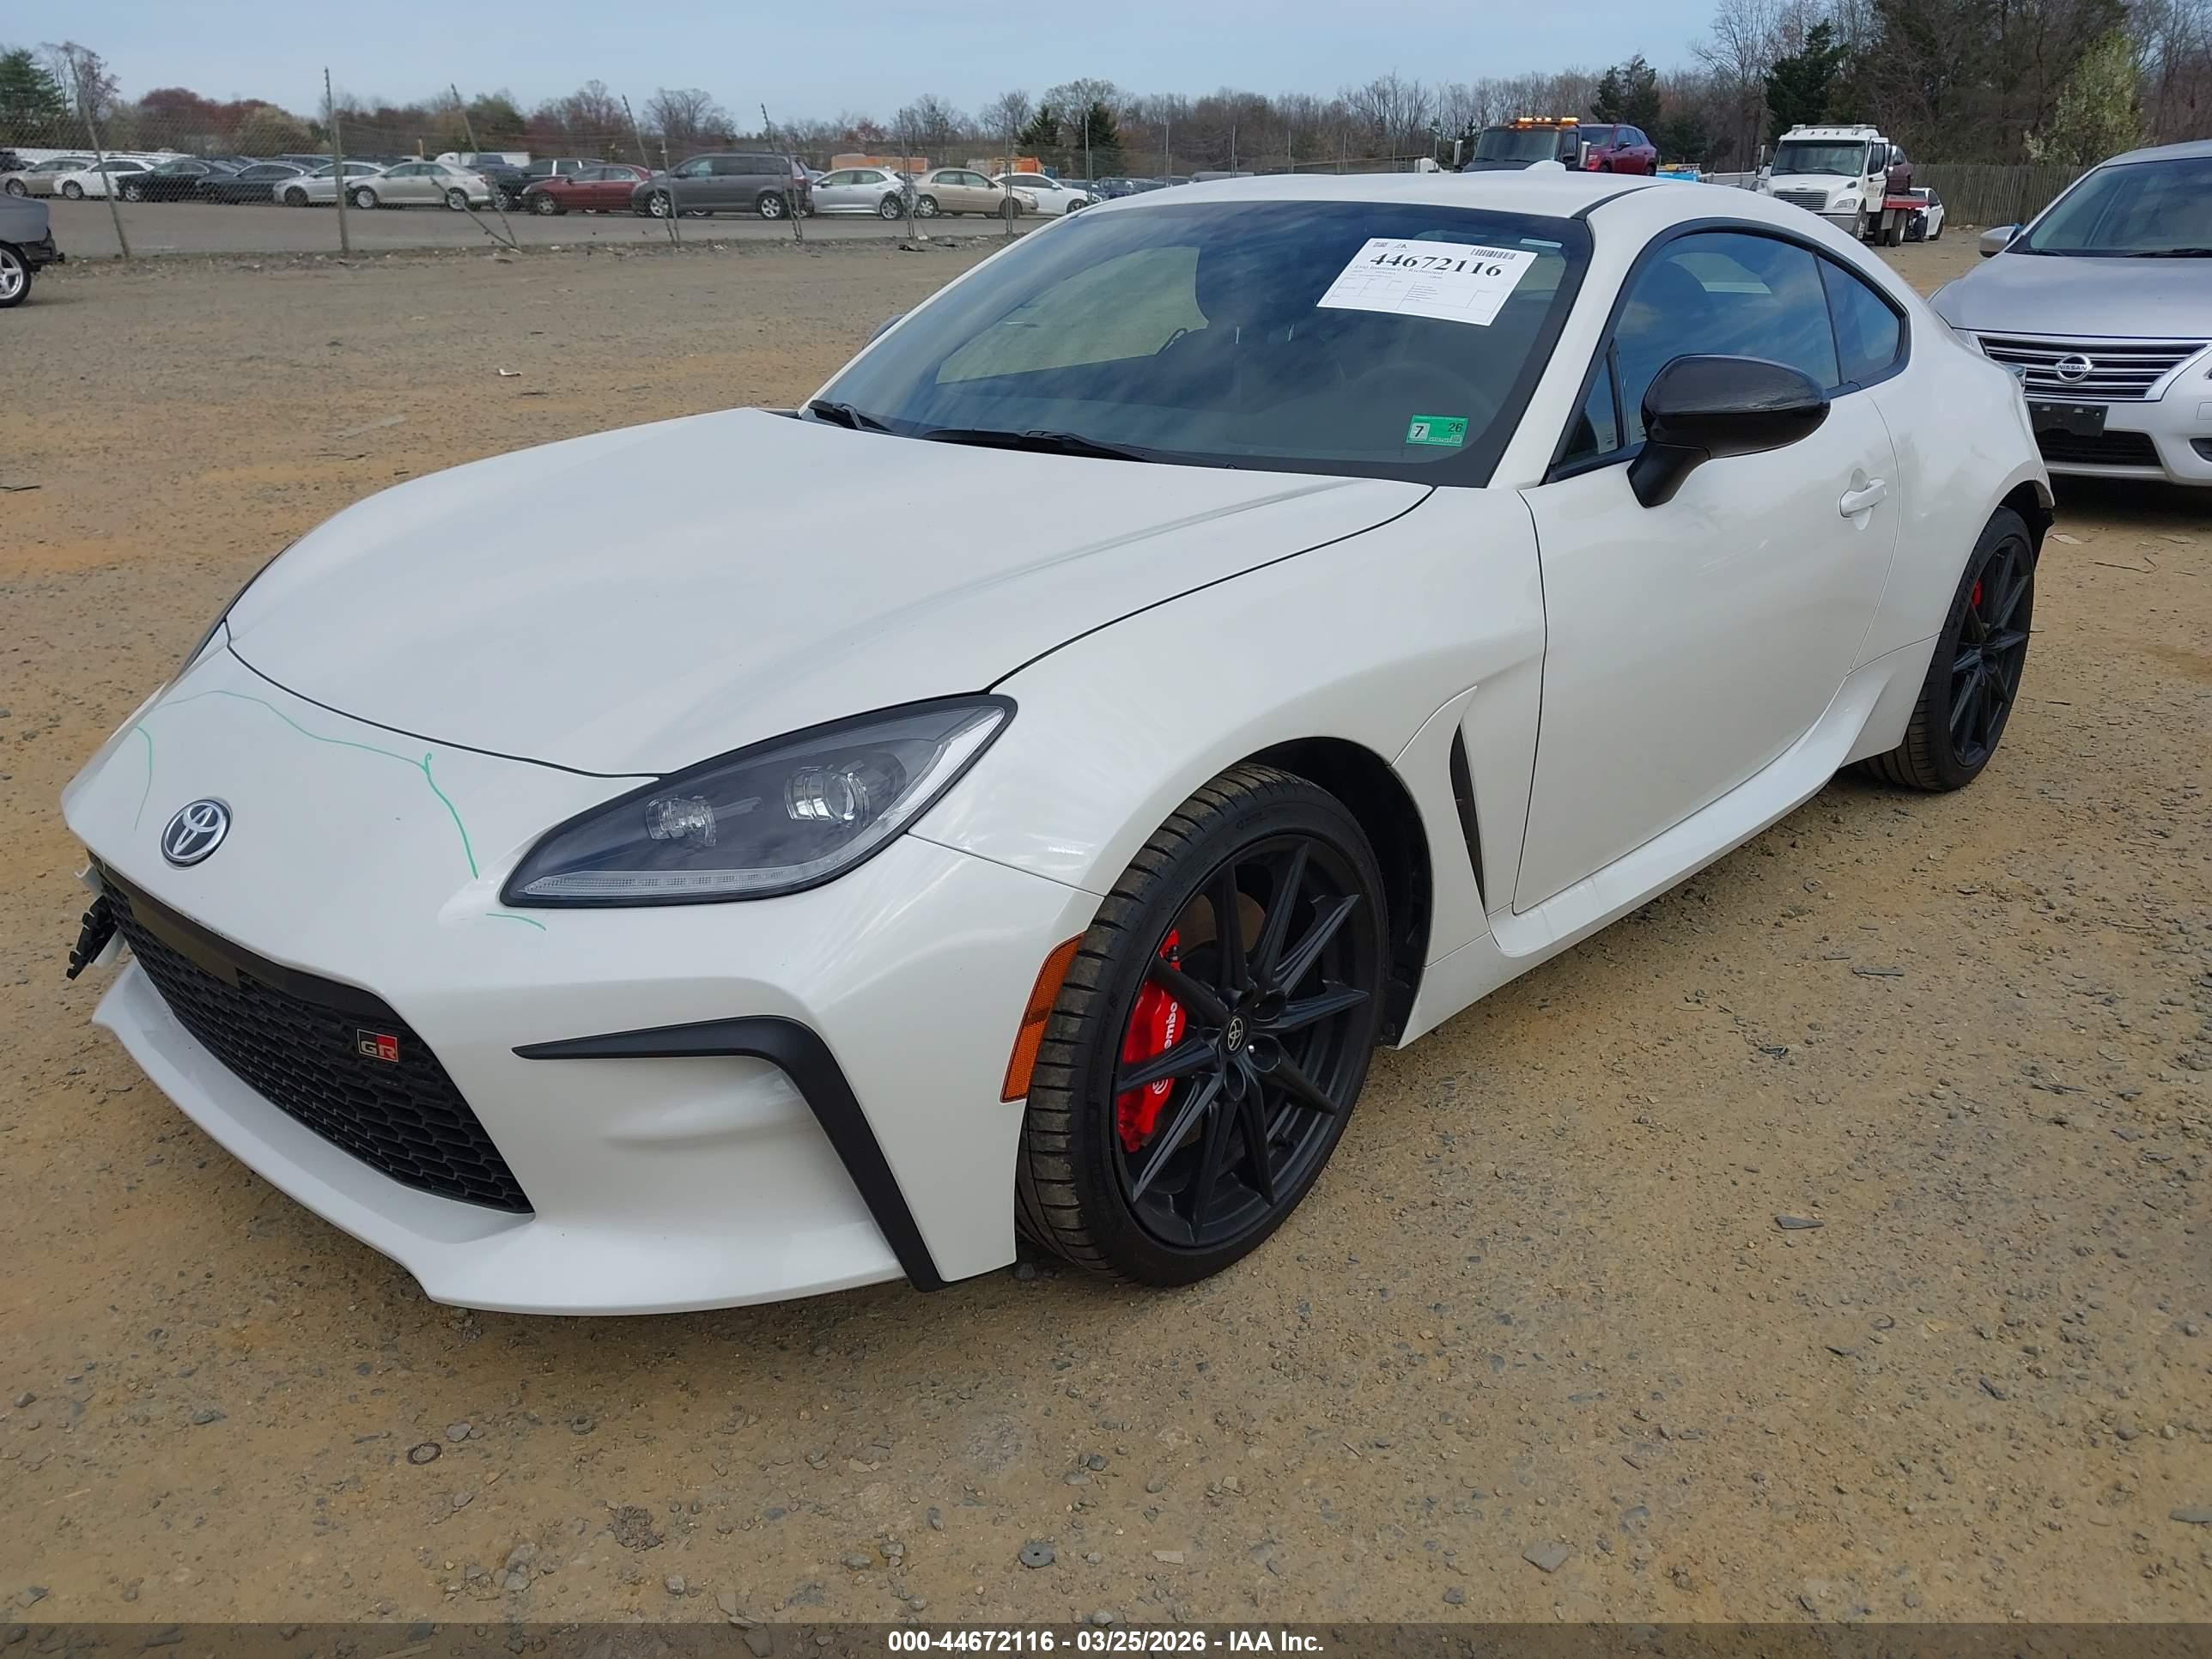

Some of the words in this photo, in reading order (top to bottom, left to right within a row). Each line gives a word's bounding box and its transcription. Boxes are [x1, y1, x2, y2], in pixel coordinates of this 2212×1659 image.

[1370, 253, 1505, 276] 44672116
[1414, 425, 1425, 438] 7
[1448, 422, 1463, 433] 26
[1164, 1001, 1177, 1049] embo
[361, 1040, 397, 1060] GR
